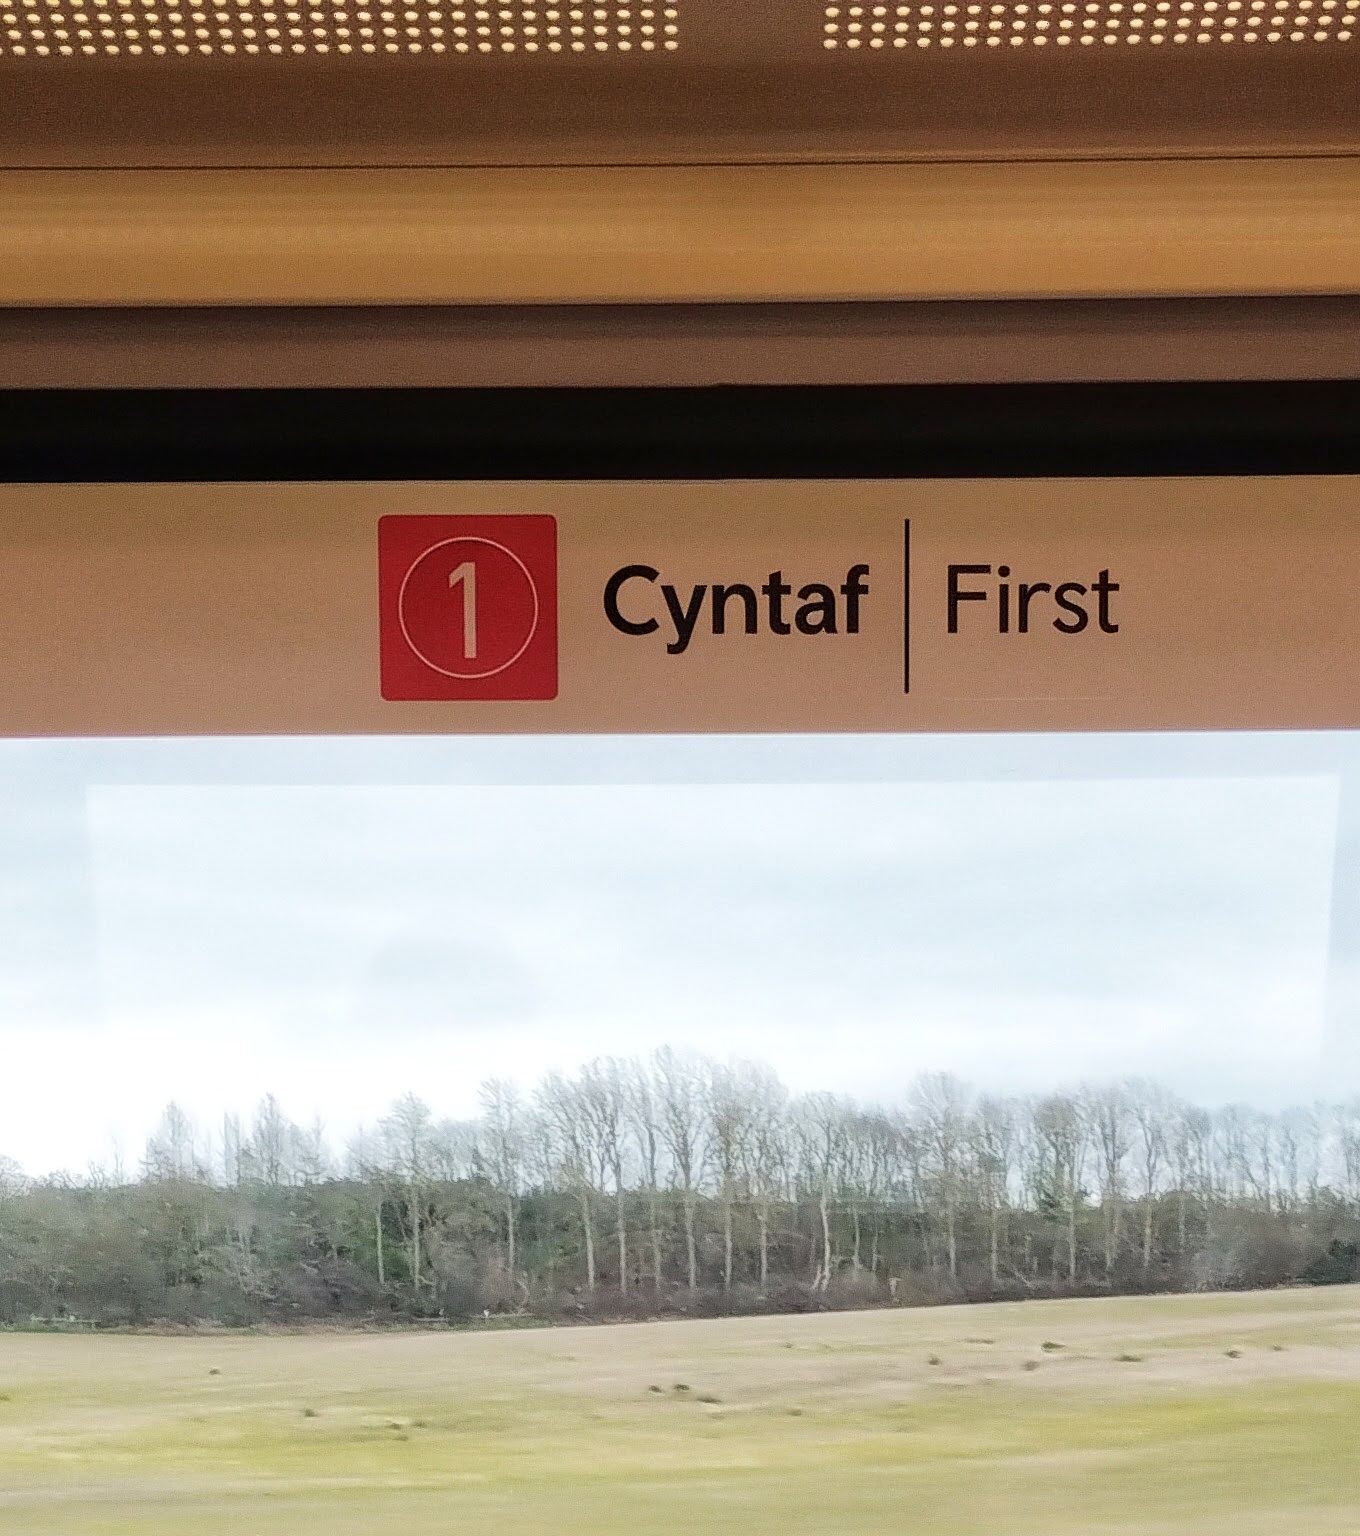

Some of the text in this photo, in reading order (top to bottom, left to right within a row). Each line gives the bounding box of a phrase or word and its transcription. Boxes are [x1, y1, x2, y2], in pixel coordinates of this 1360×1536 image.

[447, 560, 478, 660] 1
[603, 563, 1121, 655] Cyntaf First
